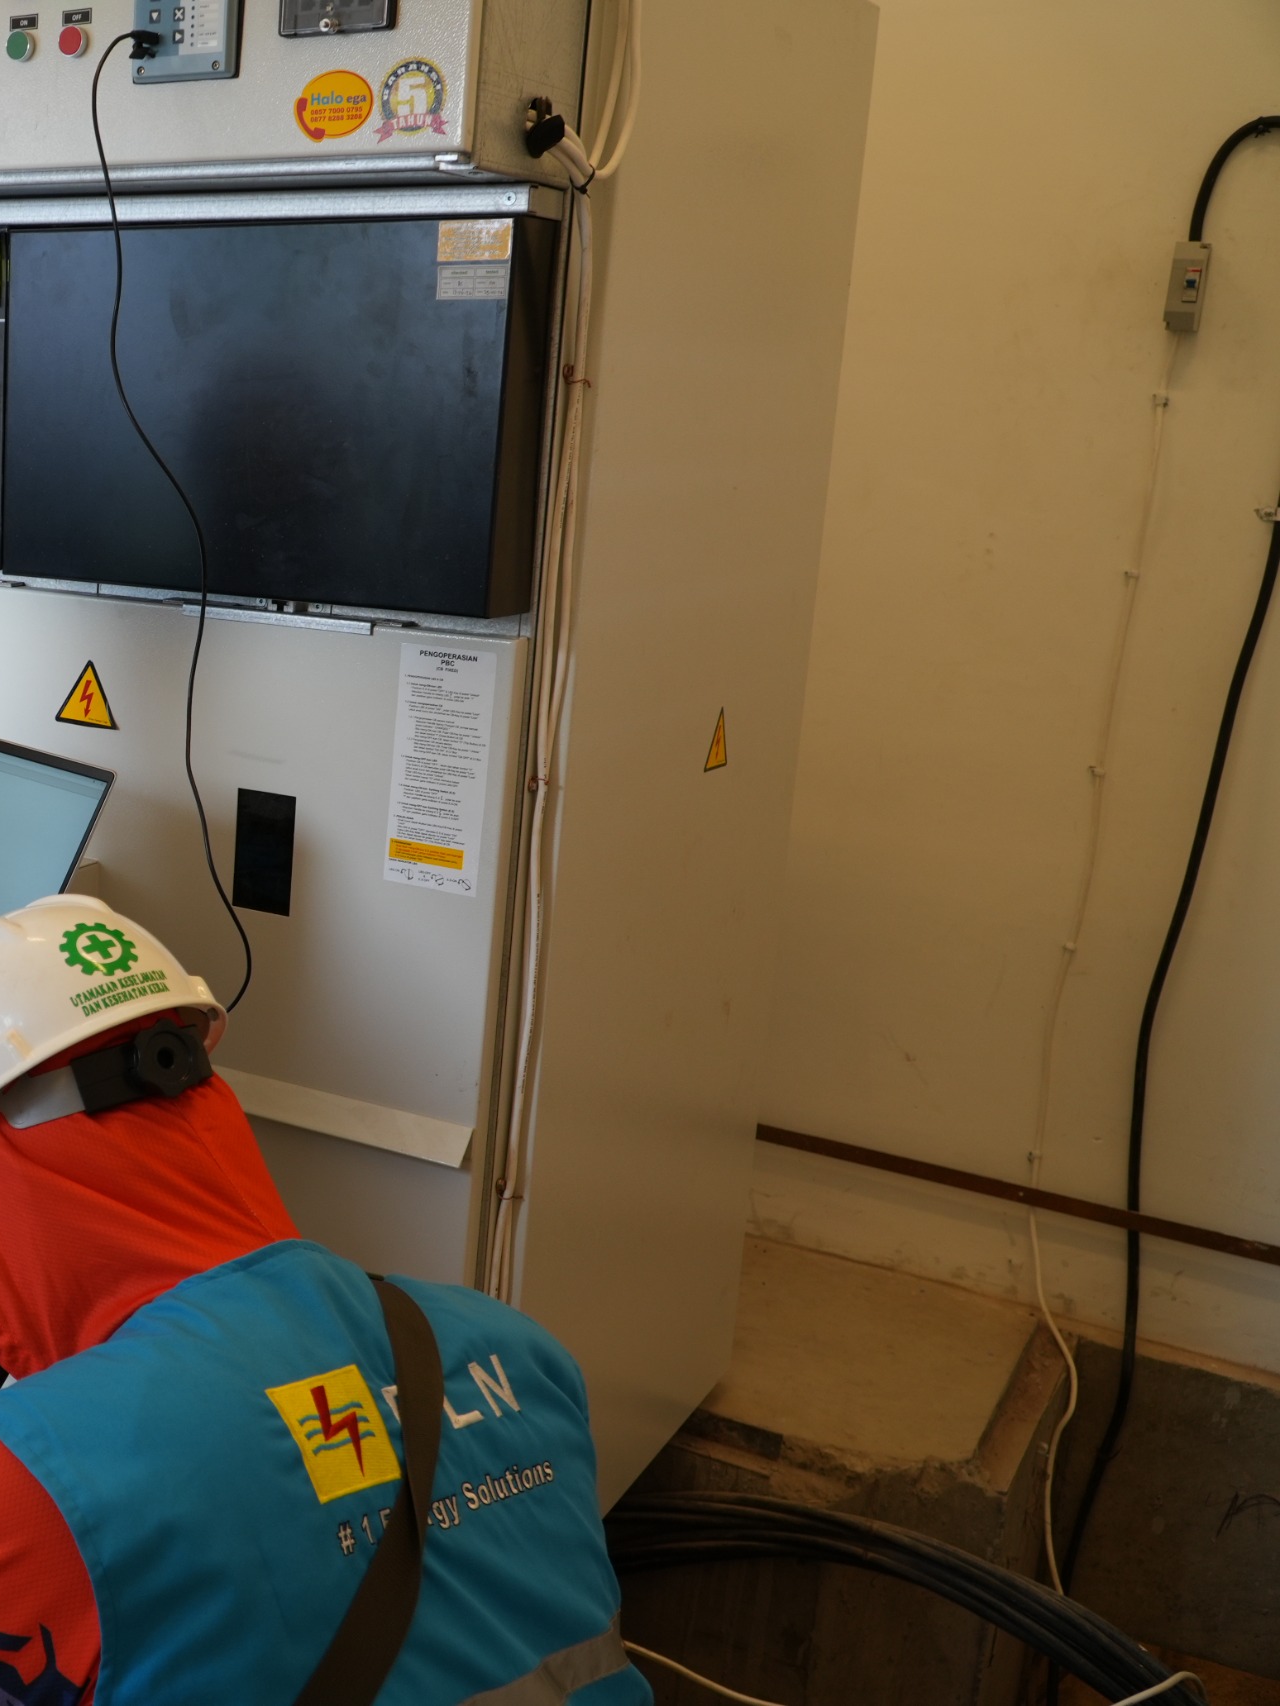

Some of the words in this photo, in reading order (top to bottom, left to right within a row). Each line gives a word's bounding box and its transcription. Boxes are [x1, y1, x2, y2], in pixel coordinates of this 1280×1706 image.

[71, 13, 82, 21] OFF
[311, 90, 344, 106] Halo
[346, 94, 367, 105] ega
[397, 76, 427, 115] 5
[391, 113, 433, 130] TAHUN
[419, 649, 479, 662] PENGOPERASIAN
[440, 659, 456, 667] PBC
[70, 981, 119, 1007] UTAMAKAN
[81, 1000, 103, 1017] DAN
[101, 985, 149, 1009] KESEHATAN
[147, 982, 171, 995] KERJA
[461, 1460, 554, 1511] Solutions
